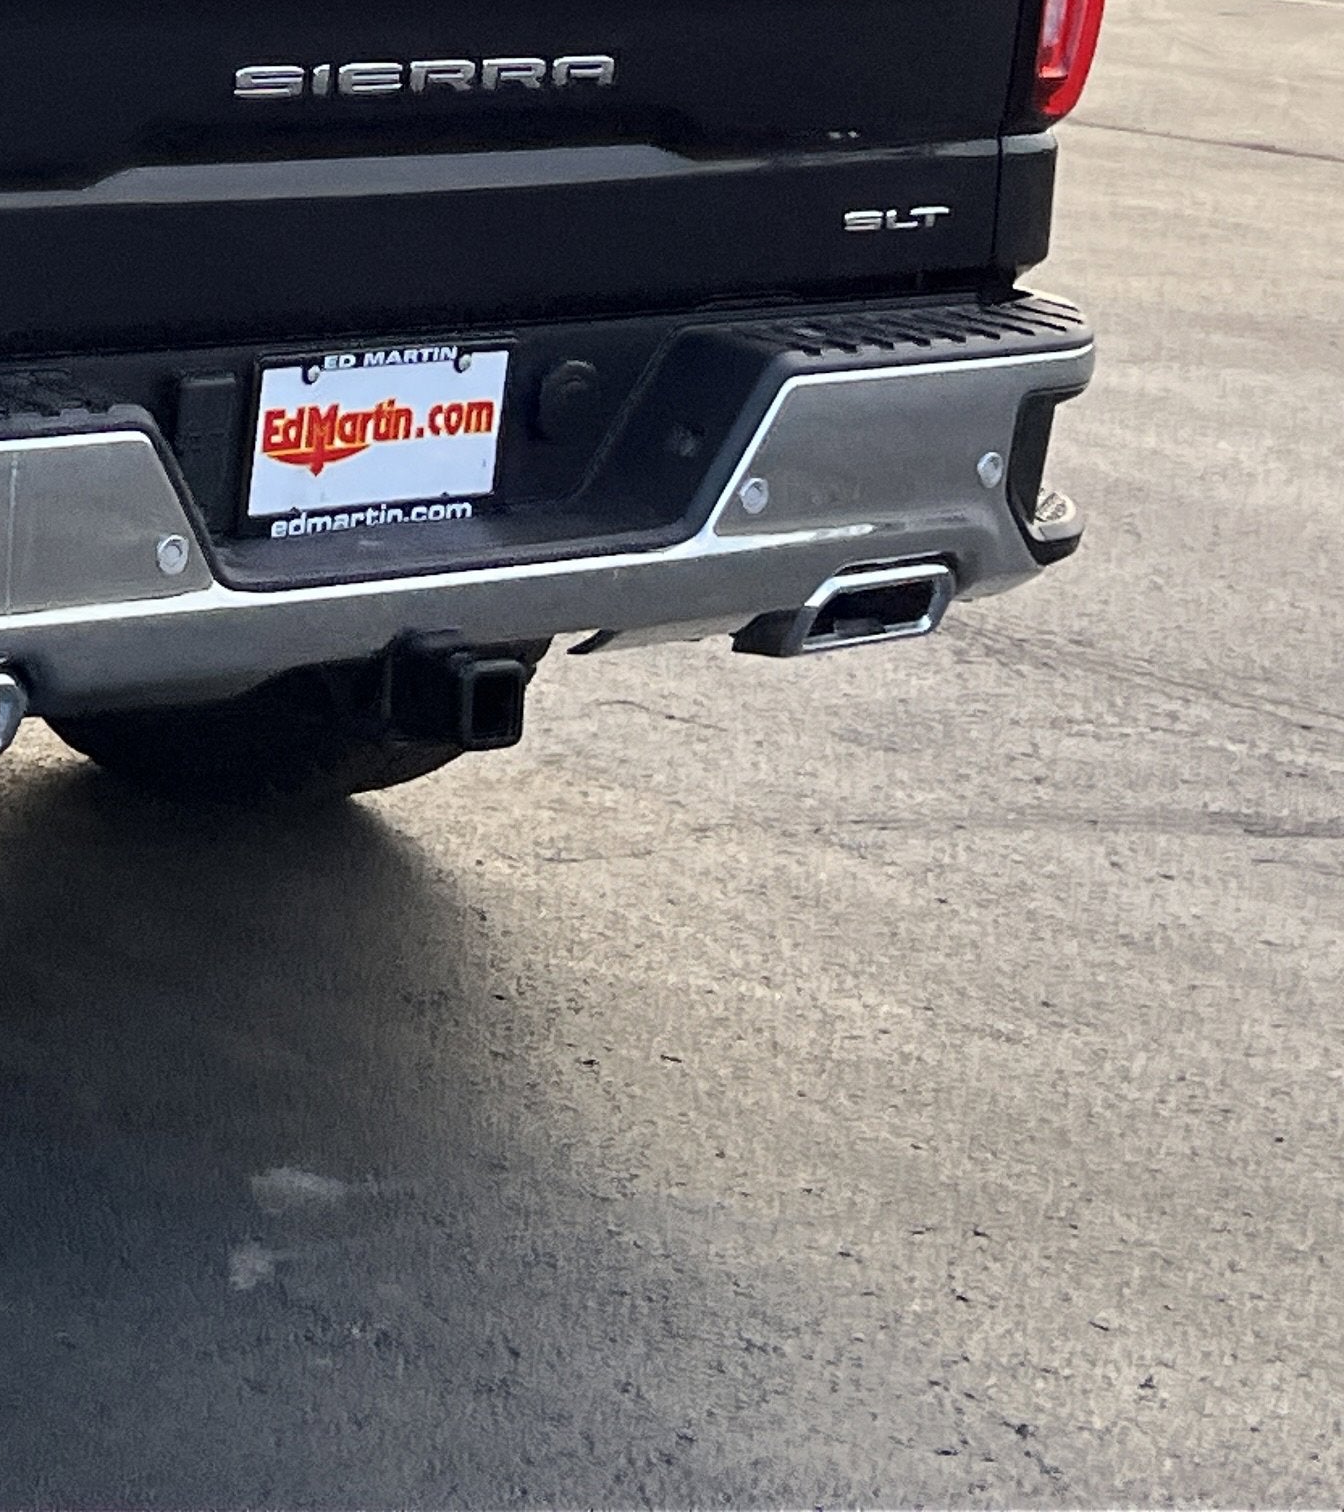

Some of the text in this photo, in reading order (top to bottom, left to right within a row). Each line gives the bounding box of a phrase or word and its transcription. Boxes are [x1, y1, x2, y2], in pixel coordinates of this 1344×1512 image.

[233, 55, 615, 99] SIERRA
[843, 205, 951, 232] SLT
[323, 346, 458, 370] ED MARTIN
[270, 500, 473, 539] edmartin.com
